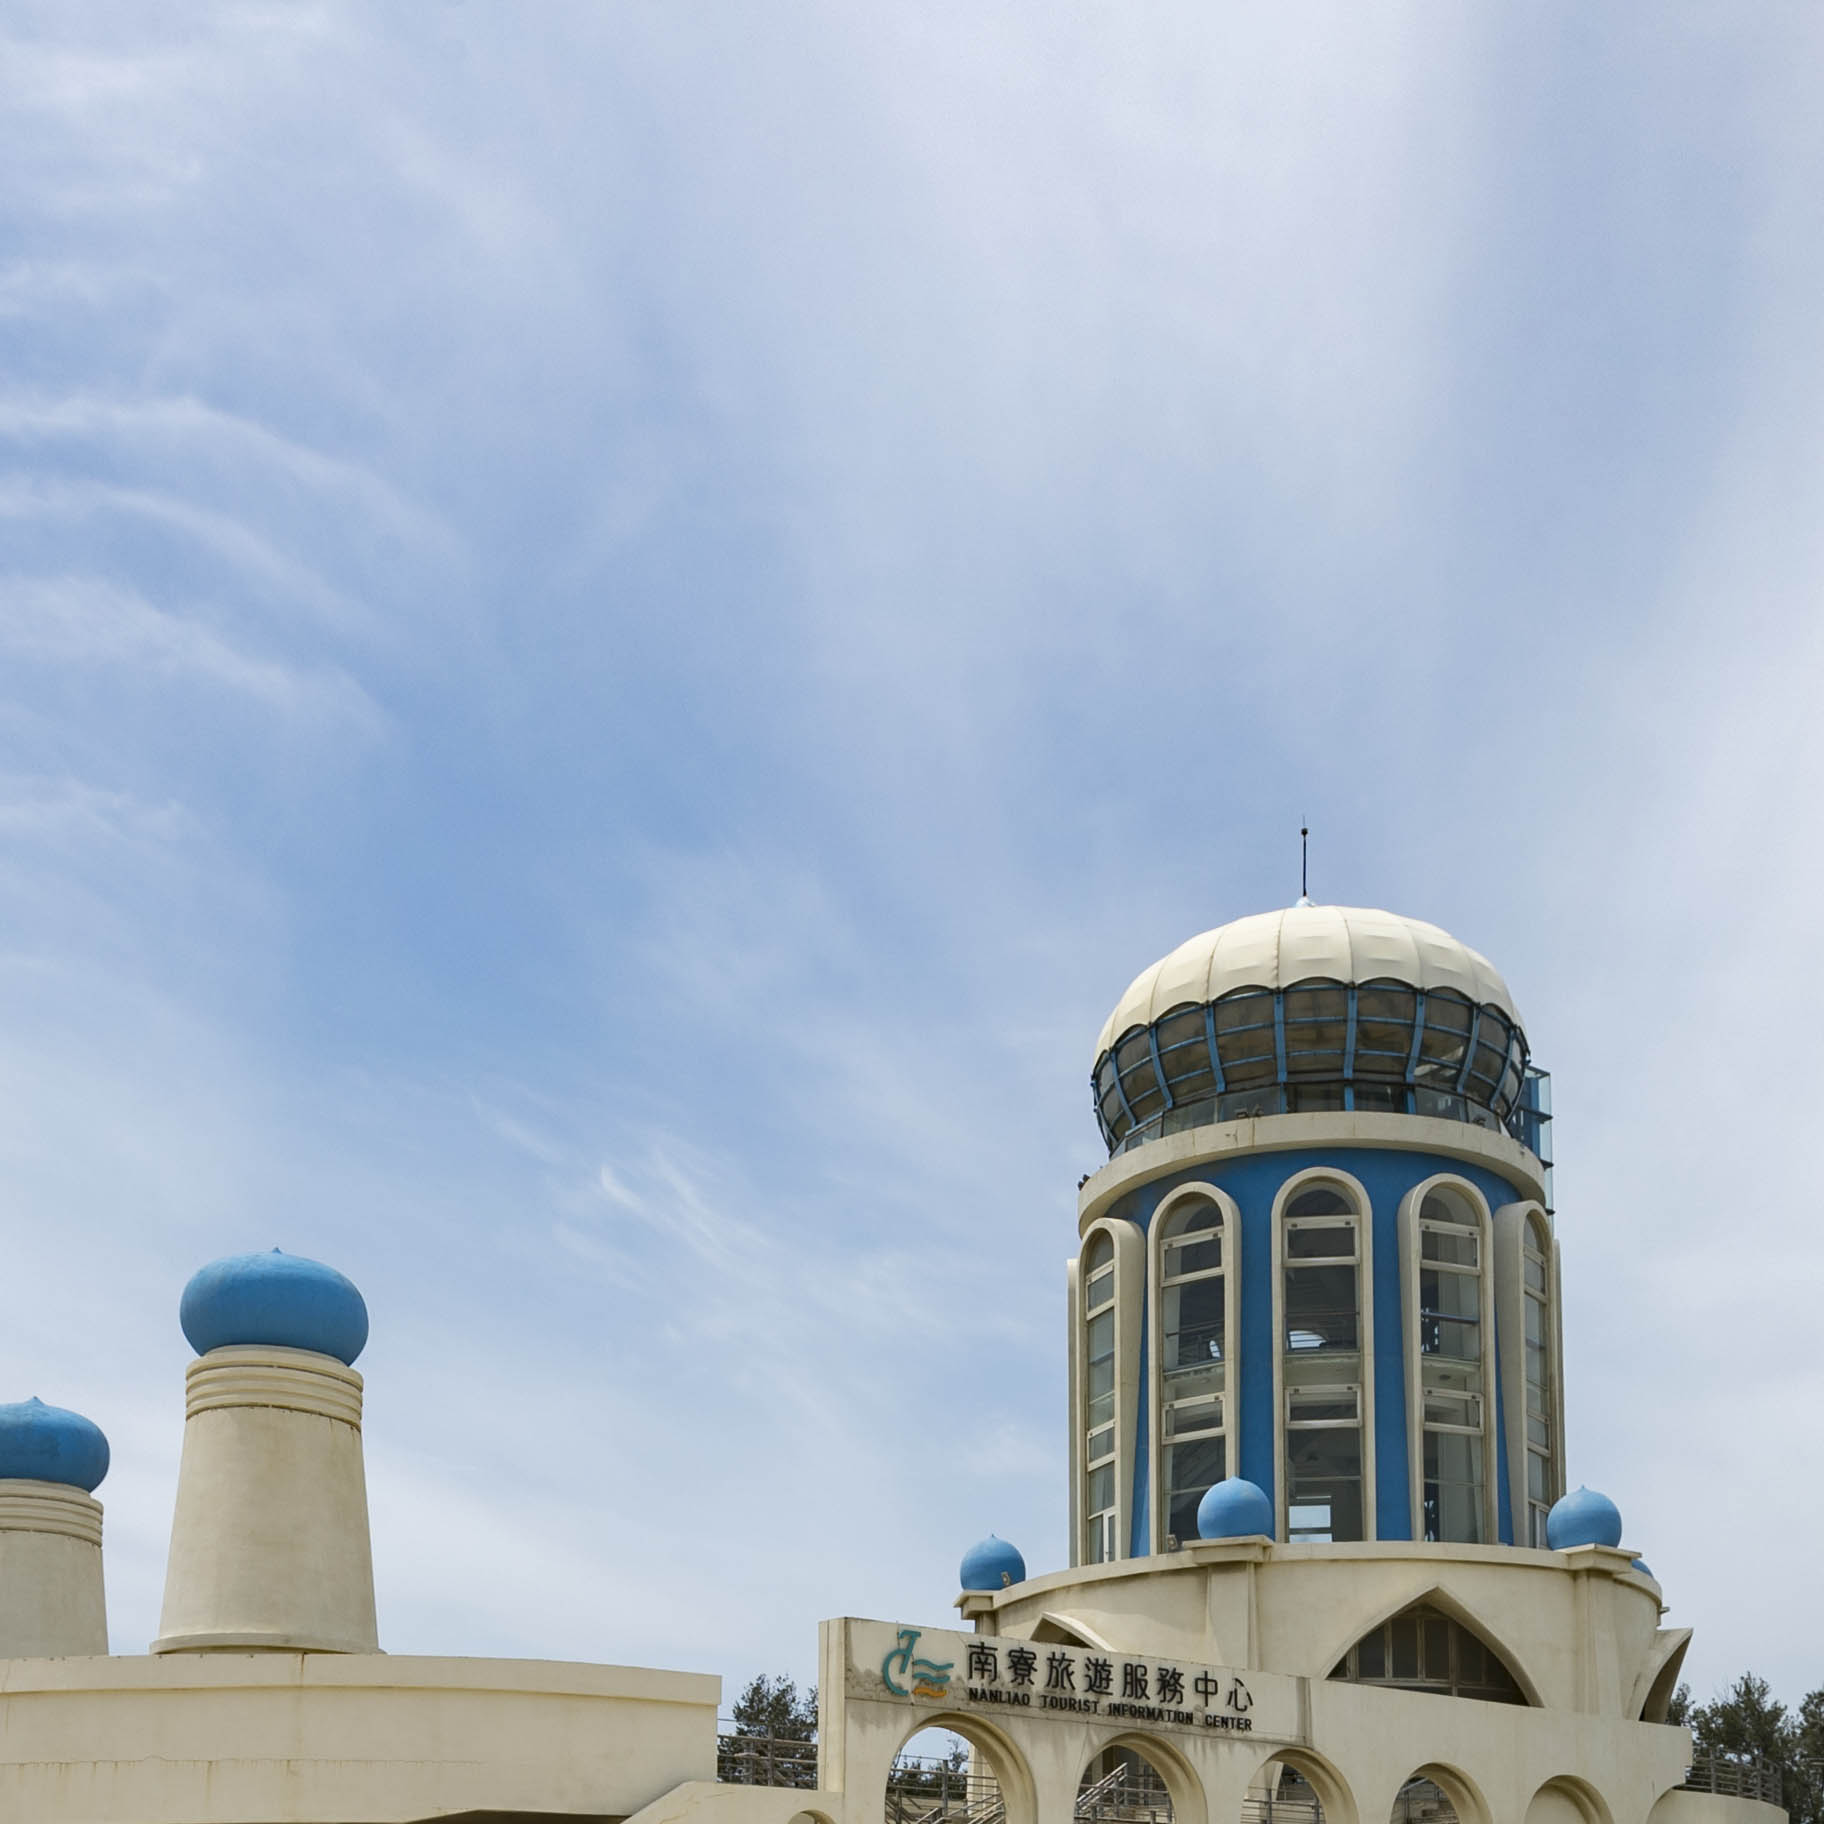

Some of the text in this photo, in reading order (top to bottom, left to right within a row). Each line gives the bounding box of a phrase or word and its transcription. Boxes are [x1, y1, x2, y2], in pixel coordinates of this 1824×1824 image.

[967, 1642, 1254, 1712] 南寮旅遊服務中心
[969, 1687, 1252, 1731] NANLIAO TOURIST INFORMATION CENTER
